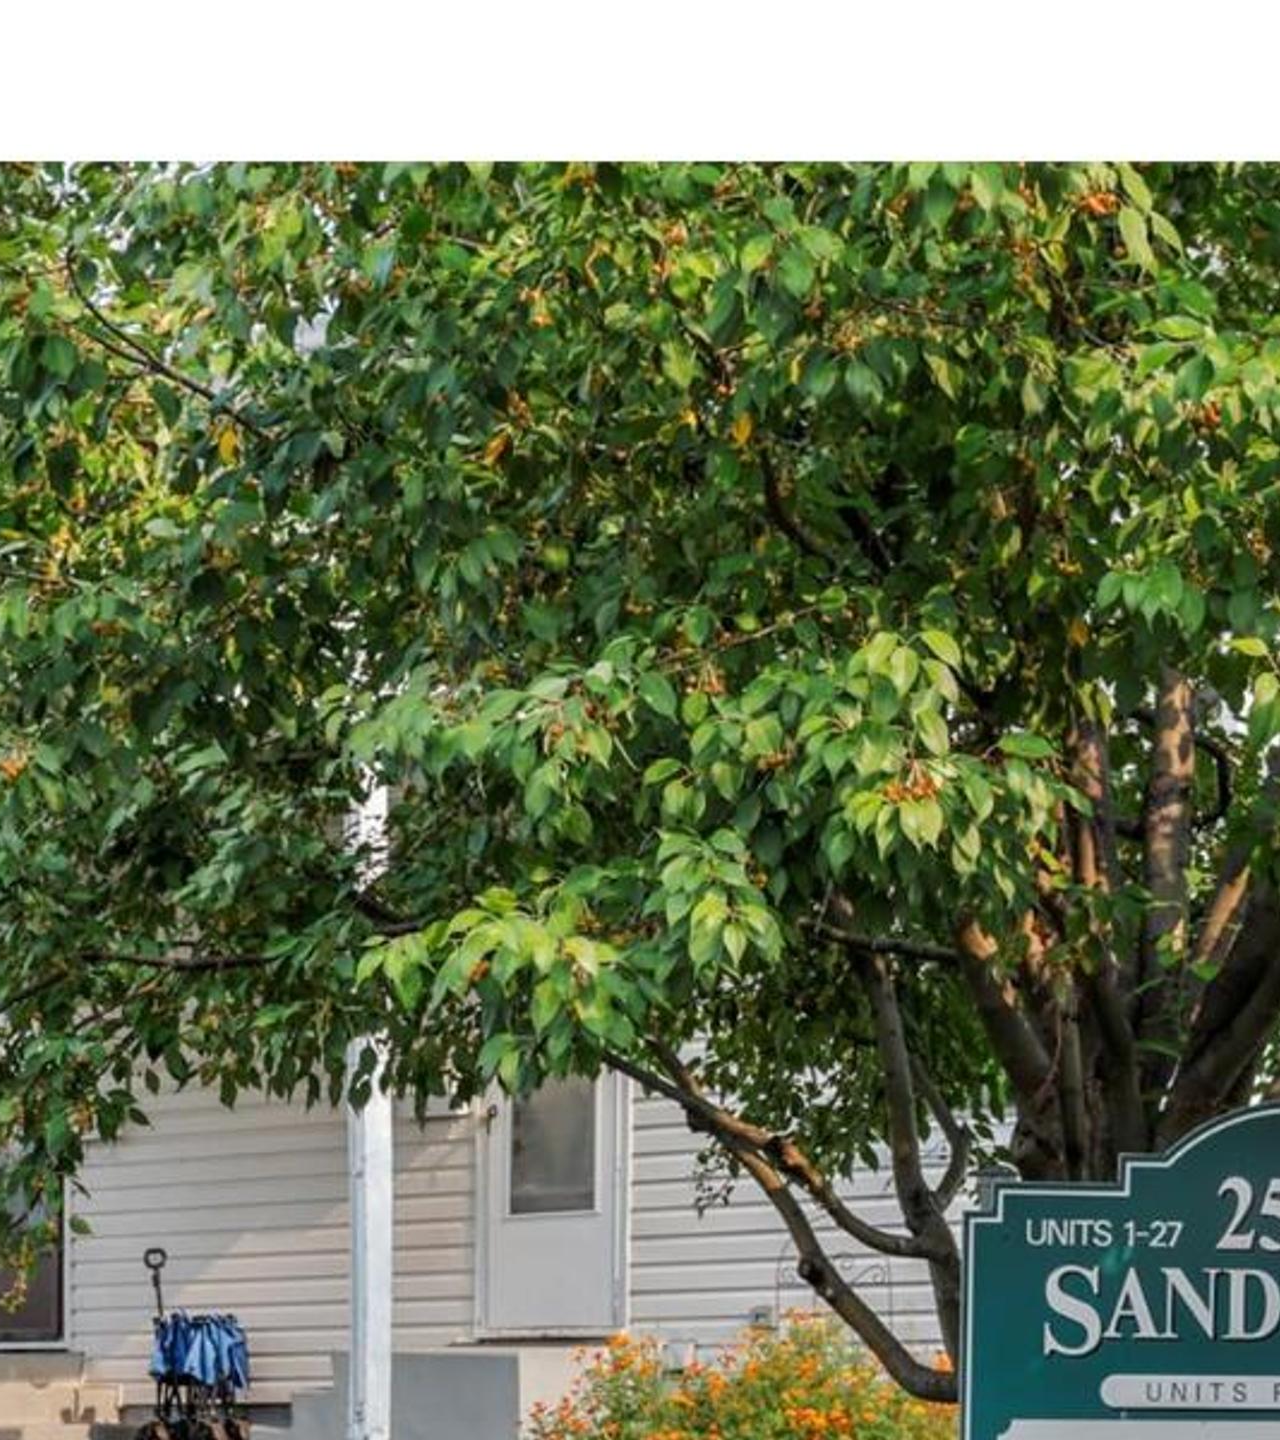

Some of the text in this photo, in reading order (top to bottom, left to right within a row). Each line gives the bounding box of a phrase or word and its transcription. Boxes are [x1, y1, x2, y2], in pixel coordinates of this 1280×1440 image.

[1025, 1219, 1184, 1249] UNITS 1-27
[1145, 1381, 1248, 1404] UNITS
